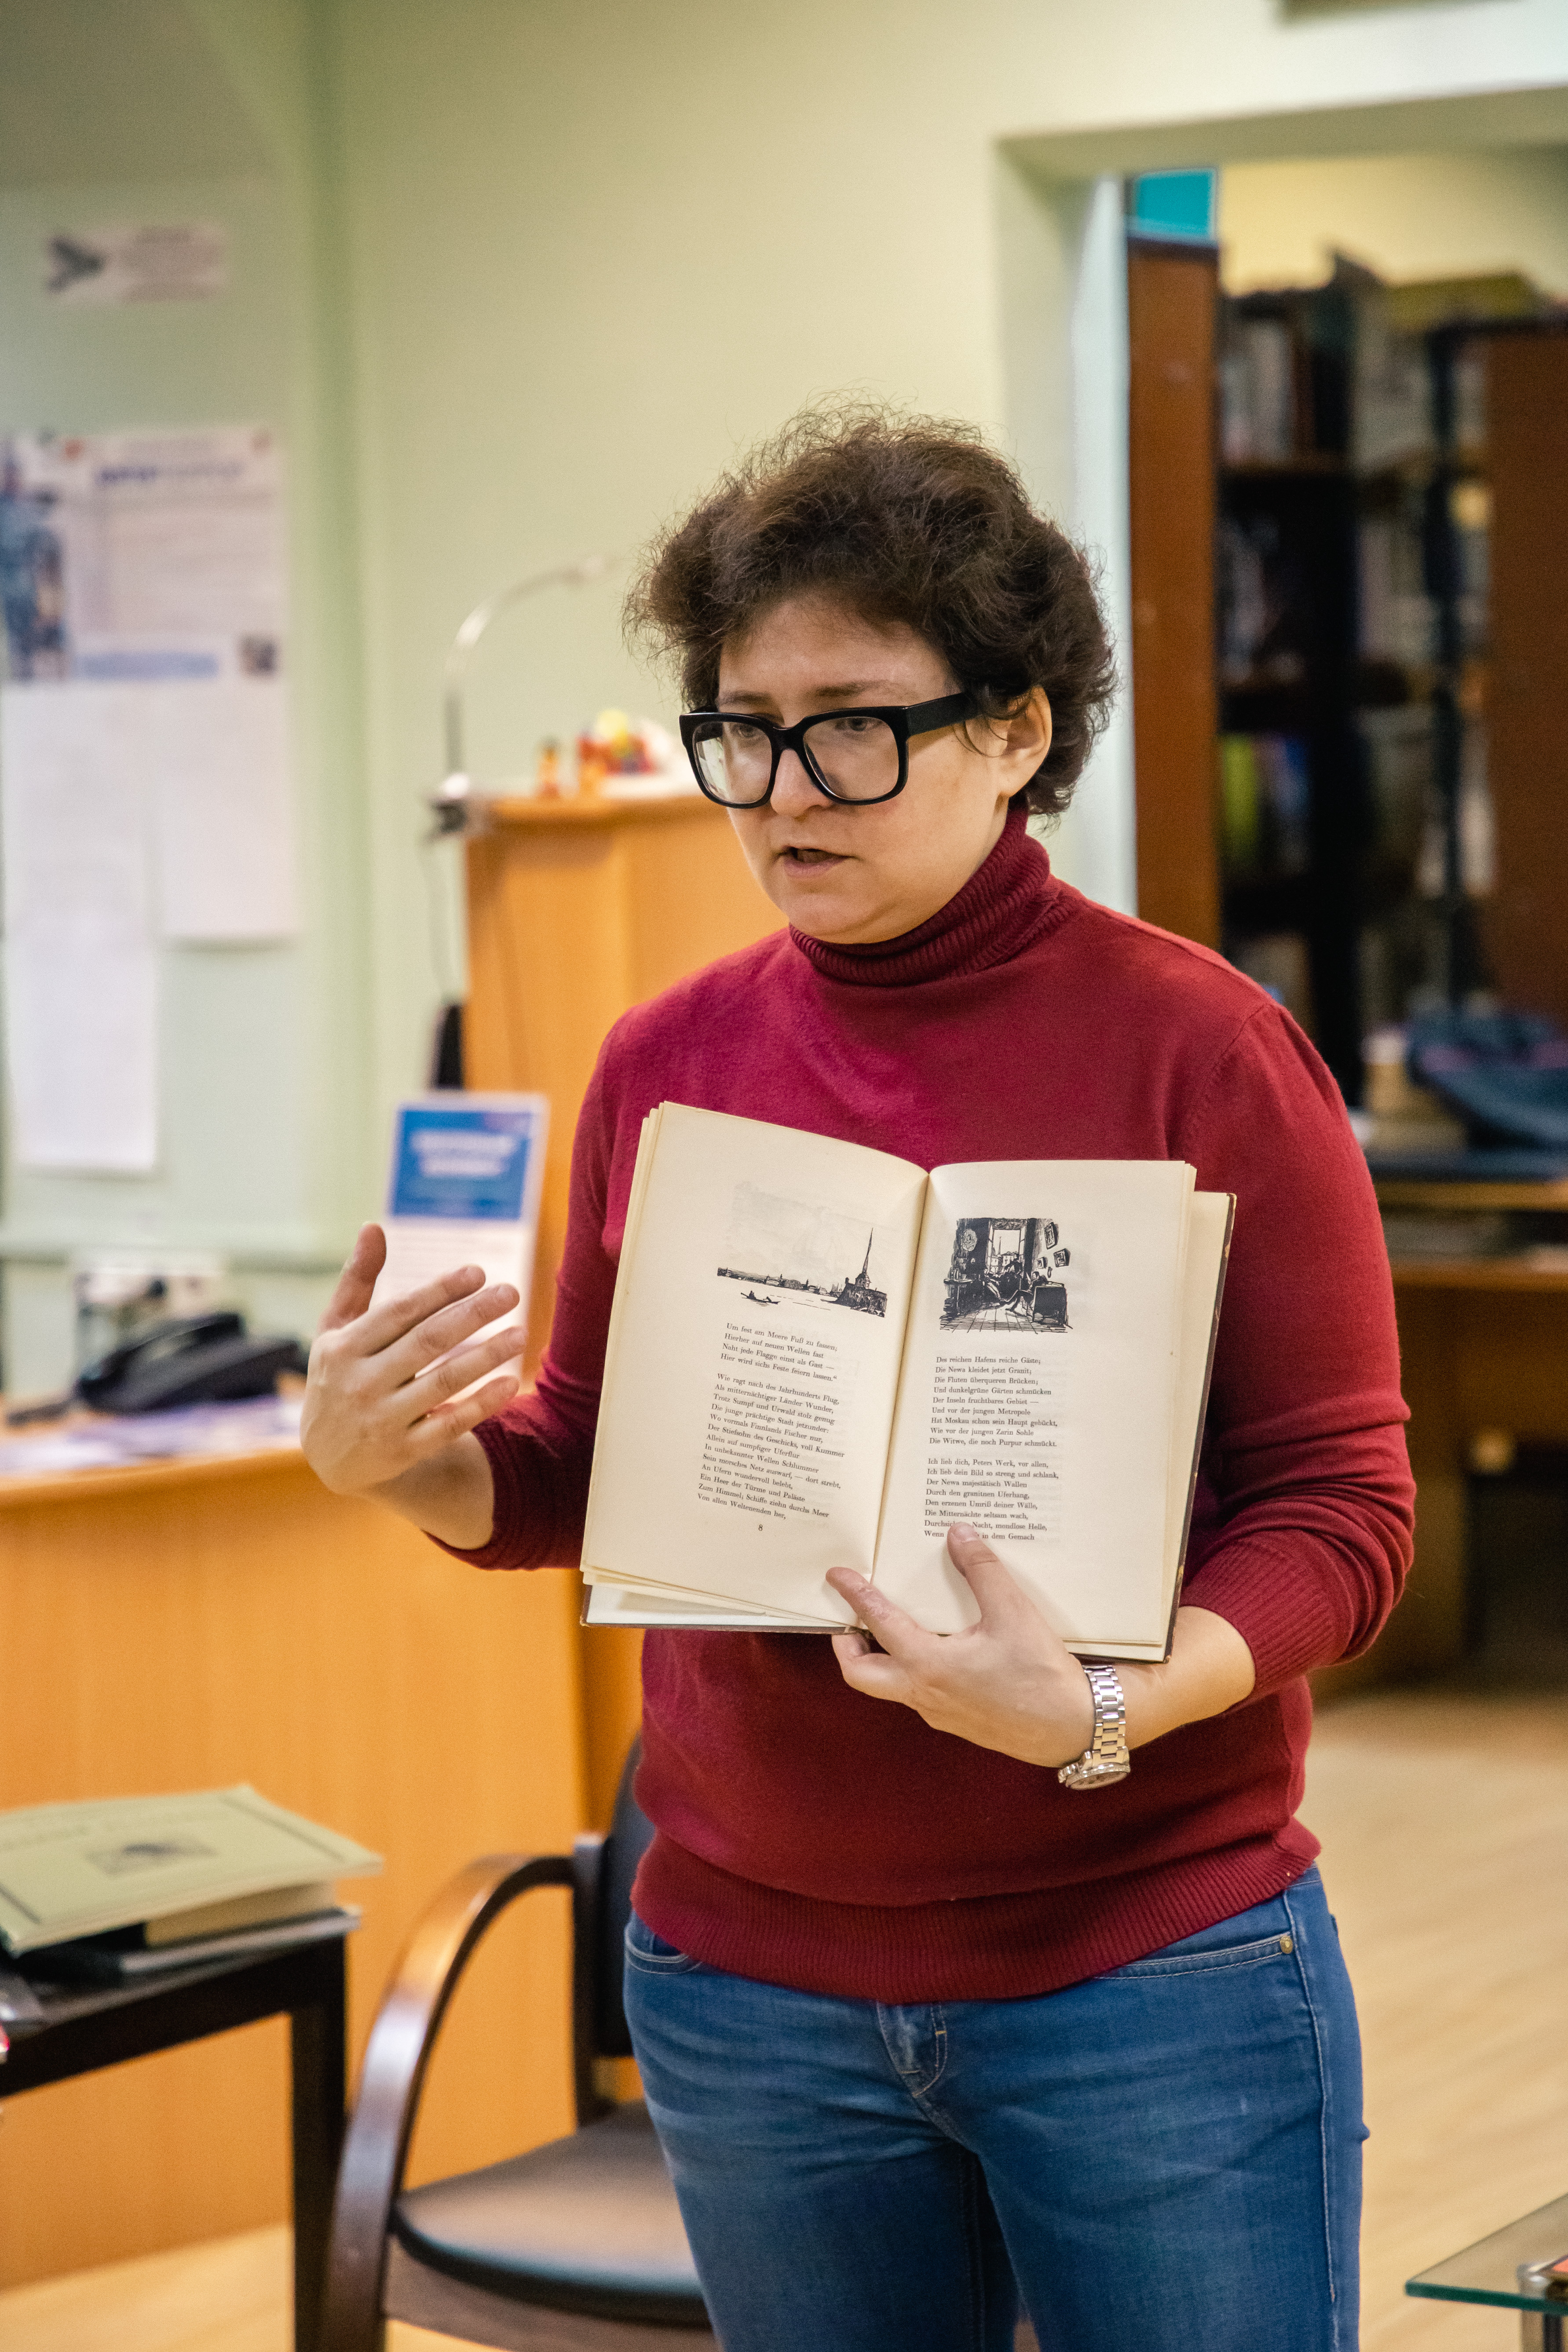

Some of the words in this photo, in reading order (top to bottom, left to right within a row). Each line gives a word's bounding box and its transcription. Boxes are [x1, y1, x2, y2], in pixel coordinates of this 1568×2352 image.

[724, 1332, 749, 1344] Hierher
[764, 1342, 784, 1351] neuen
[787, 1345, 810, 1356] Wellen
[812, 1350, 824, 1359] fast
[741, 1325, 752, 1334] fest
[768, 1330, 788, 1341] Meere
[790, 1335, 804, 1344] Fuß
[816, 1340, 837, 1352] fassen;
[720, 1352, 735, 1361] Hier
[755, 1360, 770, 1368] sichs
[772, 1363, 789, 1372] Feste
[791, 1367, 810, 1377] feiern
[1008, 1366, 1031, 1375] Granit;
[1020, 1357, 1041, 1365] Gäste;
[717, 1372, 730, 1382] Wie
[733, 1378, 746, 1386] ragt
[765, 1383, 776, 1391] des
[778, 1385, 820, 1400] Jahrhunderts
[822, 1394, 839, 1406] Flug,
[948, 1386, 989, 1395] dunkelgrüne
[970, 1376, 1006, 1385] überqueren
[1009, 1377, 1038, 1386] Brücken;
[713, 1393, 730, 1403] Trotz
[733, 1397, 755, 1408] Sumpf
[771, 1405, 796, 1416] Urwald
[814, 1415, 835, 1426] genug
[727, 1386, 777, 1402] mitternächtiger
[779, 1396, 803, 1407] Länder
[805, 1401, 833, 1415] Wunder,
[972, 1407, 995, 1416] jungen
[998, 1408, 1031, 1417] Metropole
[710, 1413, 721, 1422] Wo
[724, 1418, 748, 1427] vormals
[750, 1422, 782, 1434] Finnlands
[784, 1428, 807, 1439] Fischer
[809, 1435, 823, 1444] nur,
[711, 1403, 723, 1411] Die
[724, 1406, 743, 1417] junge
[745, 1412, 775, 1423] prächtige
[777, 1416, 793, 1426] Stadt
[796, 1421, 829, 1434] jetzunder:
[1008, 1418, 1027, 1427] Haupt
[708, 1423, 720, 1431] Der
[722, 1426, 751, 1438] Stiefsohn
[766, 1435, 798, 1450] Geschicks,
[815, 1445, 845, 1458] Kummer
[943, 1437, 966, 1446] Witwe,
[998, 1438, 1022, 1448] Purpur
[971, 1428, 993, 1437] jungen
[705, 1442, 712, 1451] In
[714, 1447, 754, 1459] unbekannter
[757, 1454, 779, 1465] Wellen
[782, 1459, 819, 1474] Schlummer
[706, 1434, 725, 1443] Allein
[739, 1442, 771, 1454] sumpfiger
[774, 1447, 800, 1459] Uferflur
[954, 1458, 970, 1467] dich,
[995, 1459, 1015, 1468] Werk,
[1031, 1460, 1049, 1469] allen,
[995, 1471, 1015, 1479] streng
[1033, 1471, 1059, 1480] schlank,
[700, 1472, 711, 1481] Ein
[713, 1476, 729, 1485] Heer
[744, 1482, 766, 1493] Türme
[783, 1491, 805, 1502] Paläste
[714, 1465, 731, 1476] Ufern
[734, 1472, 769, 1484] wundervoll
[772, 1478, 793, 1490] belebt,
[698, 1482, 713, 1492] Zum
[716, 1486, 743, 1500] Himmel;
[746, 1493, 767, 1504] Schiffe
[769, 1499, 786, 1508] ziehn
[789, 1503, 810, 1514] durchs
[811, 1508, 830, 1518] Meer
[698, 1492, 709, 1502] Von
[712, 1496, 727, 1506] allen
[730, 1500, 771, 1516] Weltenenden
[774, 1510, 786, 1520] her,
[963, 1490, 994, 1499] granitnen
[998, 1490, 1030, 1500] Uferhang,
[1017, 1501, 1038, 1511] Wälle,
[939, 1509, 981, 1518] Mitternächte
[1009, 1512, 1028, 1521] wach,
